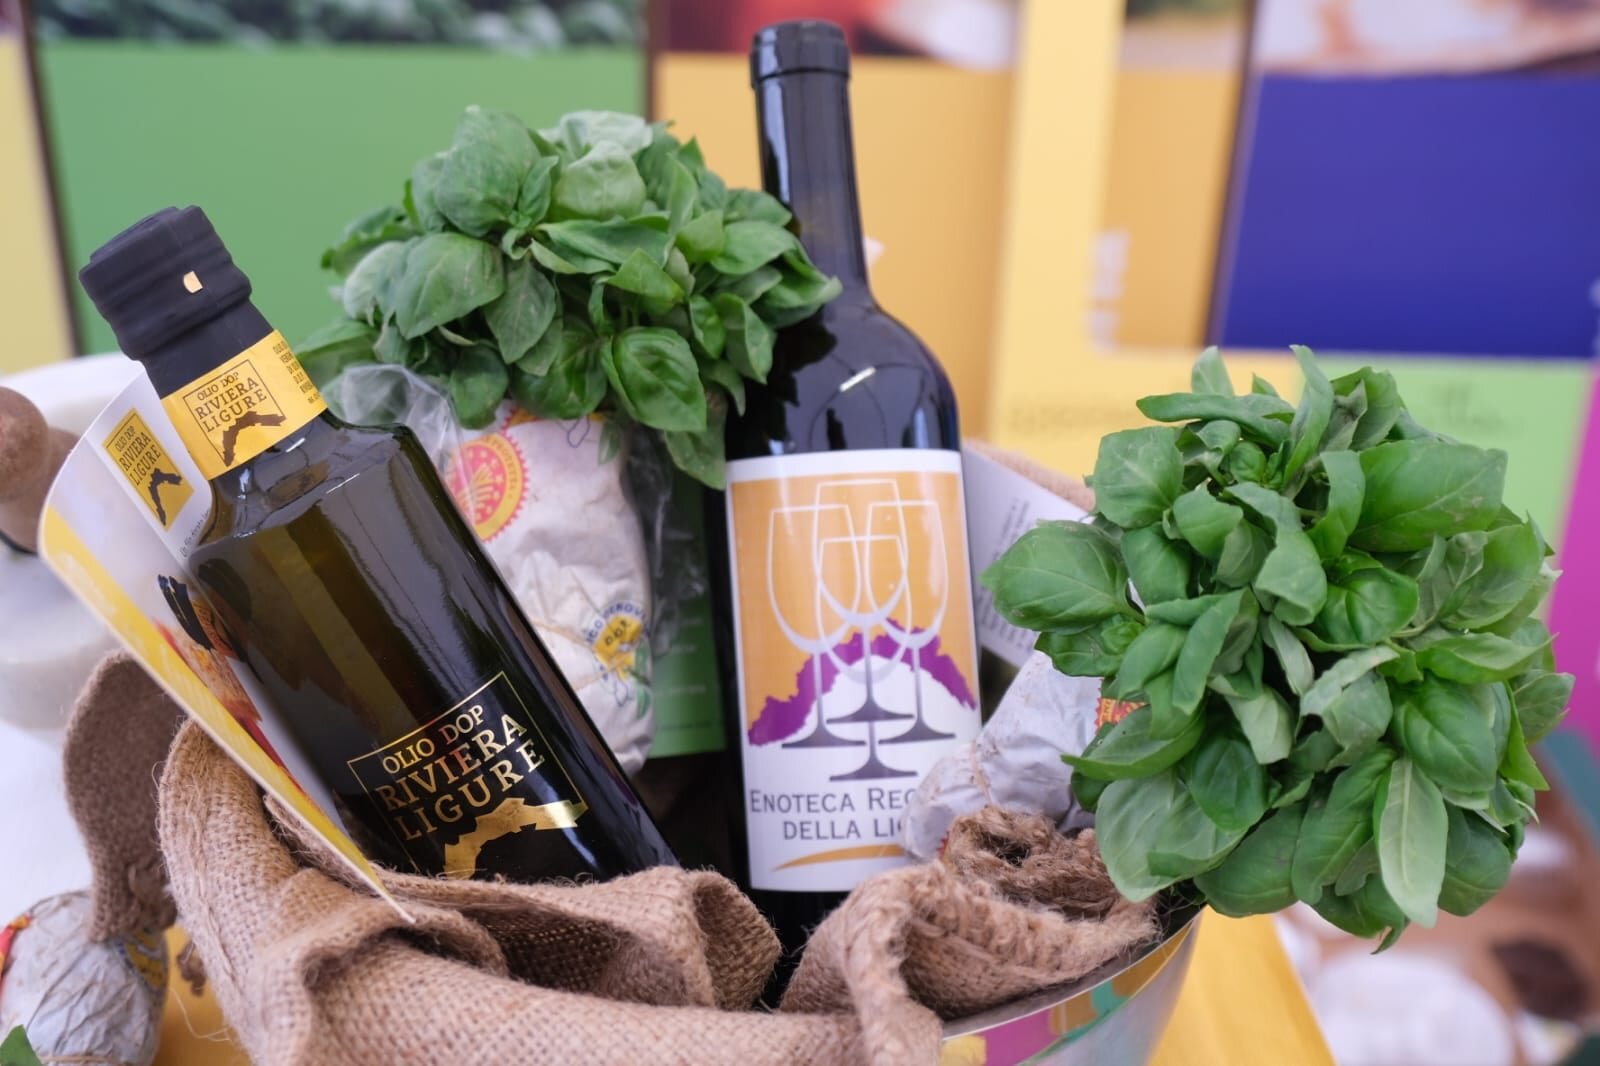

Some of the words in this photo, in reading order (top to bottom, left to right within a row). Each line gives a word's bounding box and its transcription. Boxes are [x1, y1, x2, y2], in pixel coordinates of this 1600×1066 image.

[195, 377, 259, 420] RIVIERA
[197, 384, 219, 401] OLIO
[221, 371, 239, 388] DOP
[203, 389, 267, 433] LIGURE
[119, 432, 152, 471] RIVIERA
[129, 444, 161, 486] LIGURE
[382, 738, 436, 775] OLIO
[439, 704, 485, 746] DOP
[374, 713, 528, 812] RIVIERA
[394, 739, 546, 841] LIGURE
[750, 789, 855, 813] ENOTECA
[784, 819, 861, 841] DELLA
[874, 817, 902, 838] LI
